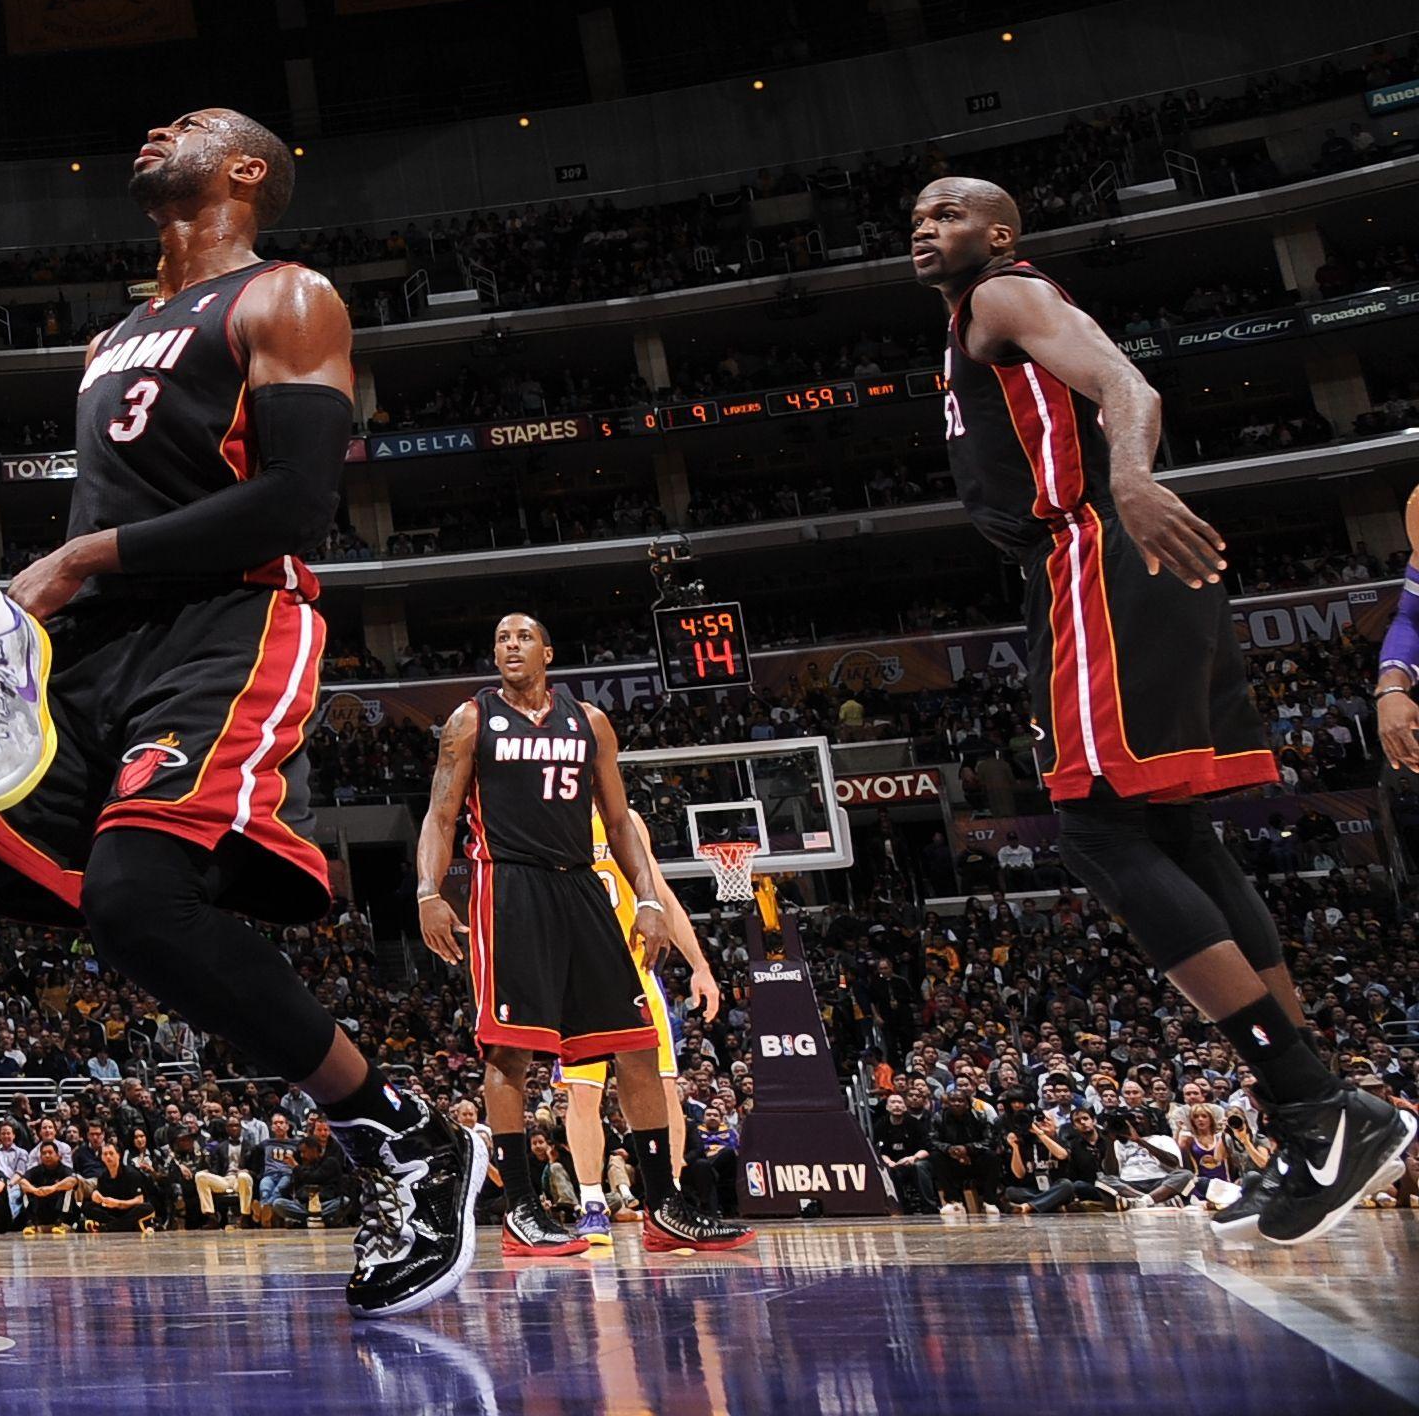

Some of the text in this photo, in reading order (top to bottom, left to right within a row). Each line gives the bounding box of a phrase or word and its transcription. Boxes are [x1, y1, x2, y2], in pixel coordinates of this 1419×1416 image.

[1311, 300, 1387, 325] Panasonic
[1118, 336, 1160, 354] NUEL
[1178, 318, 1296, 346] BUD LIGHT
[108, 378, 160, 443] 3
[400, 430, 473, 454] DELTA
[490, 418, 578, 448] STAPLES
[4, 458, 77, 480] TOYOT
[680, 612, 734, 637] 4:59
[693, 638, 736, 679] 14
[494, 737, 586, 763] MIAMI
[541, 766, 580, 801] 15
[753, 968, 802, 983] SPALDING
[774, 1163, 866, 1192] NBA TV
